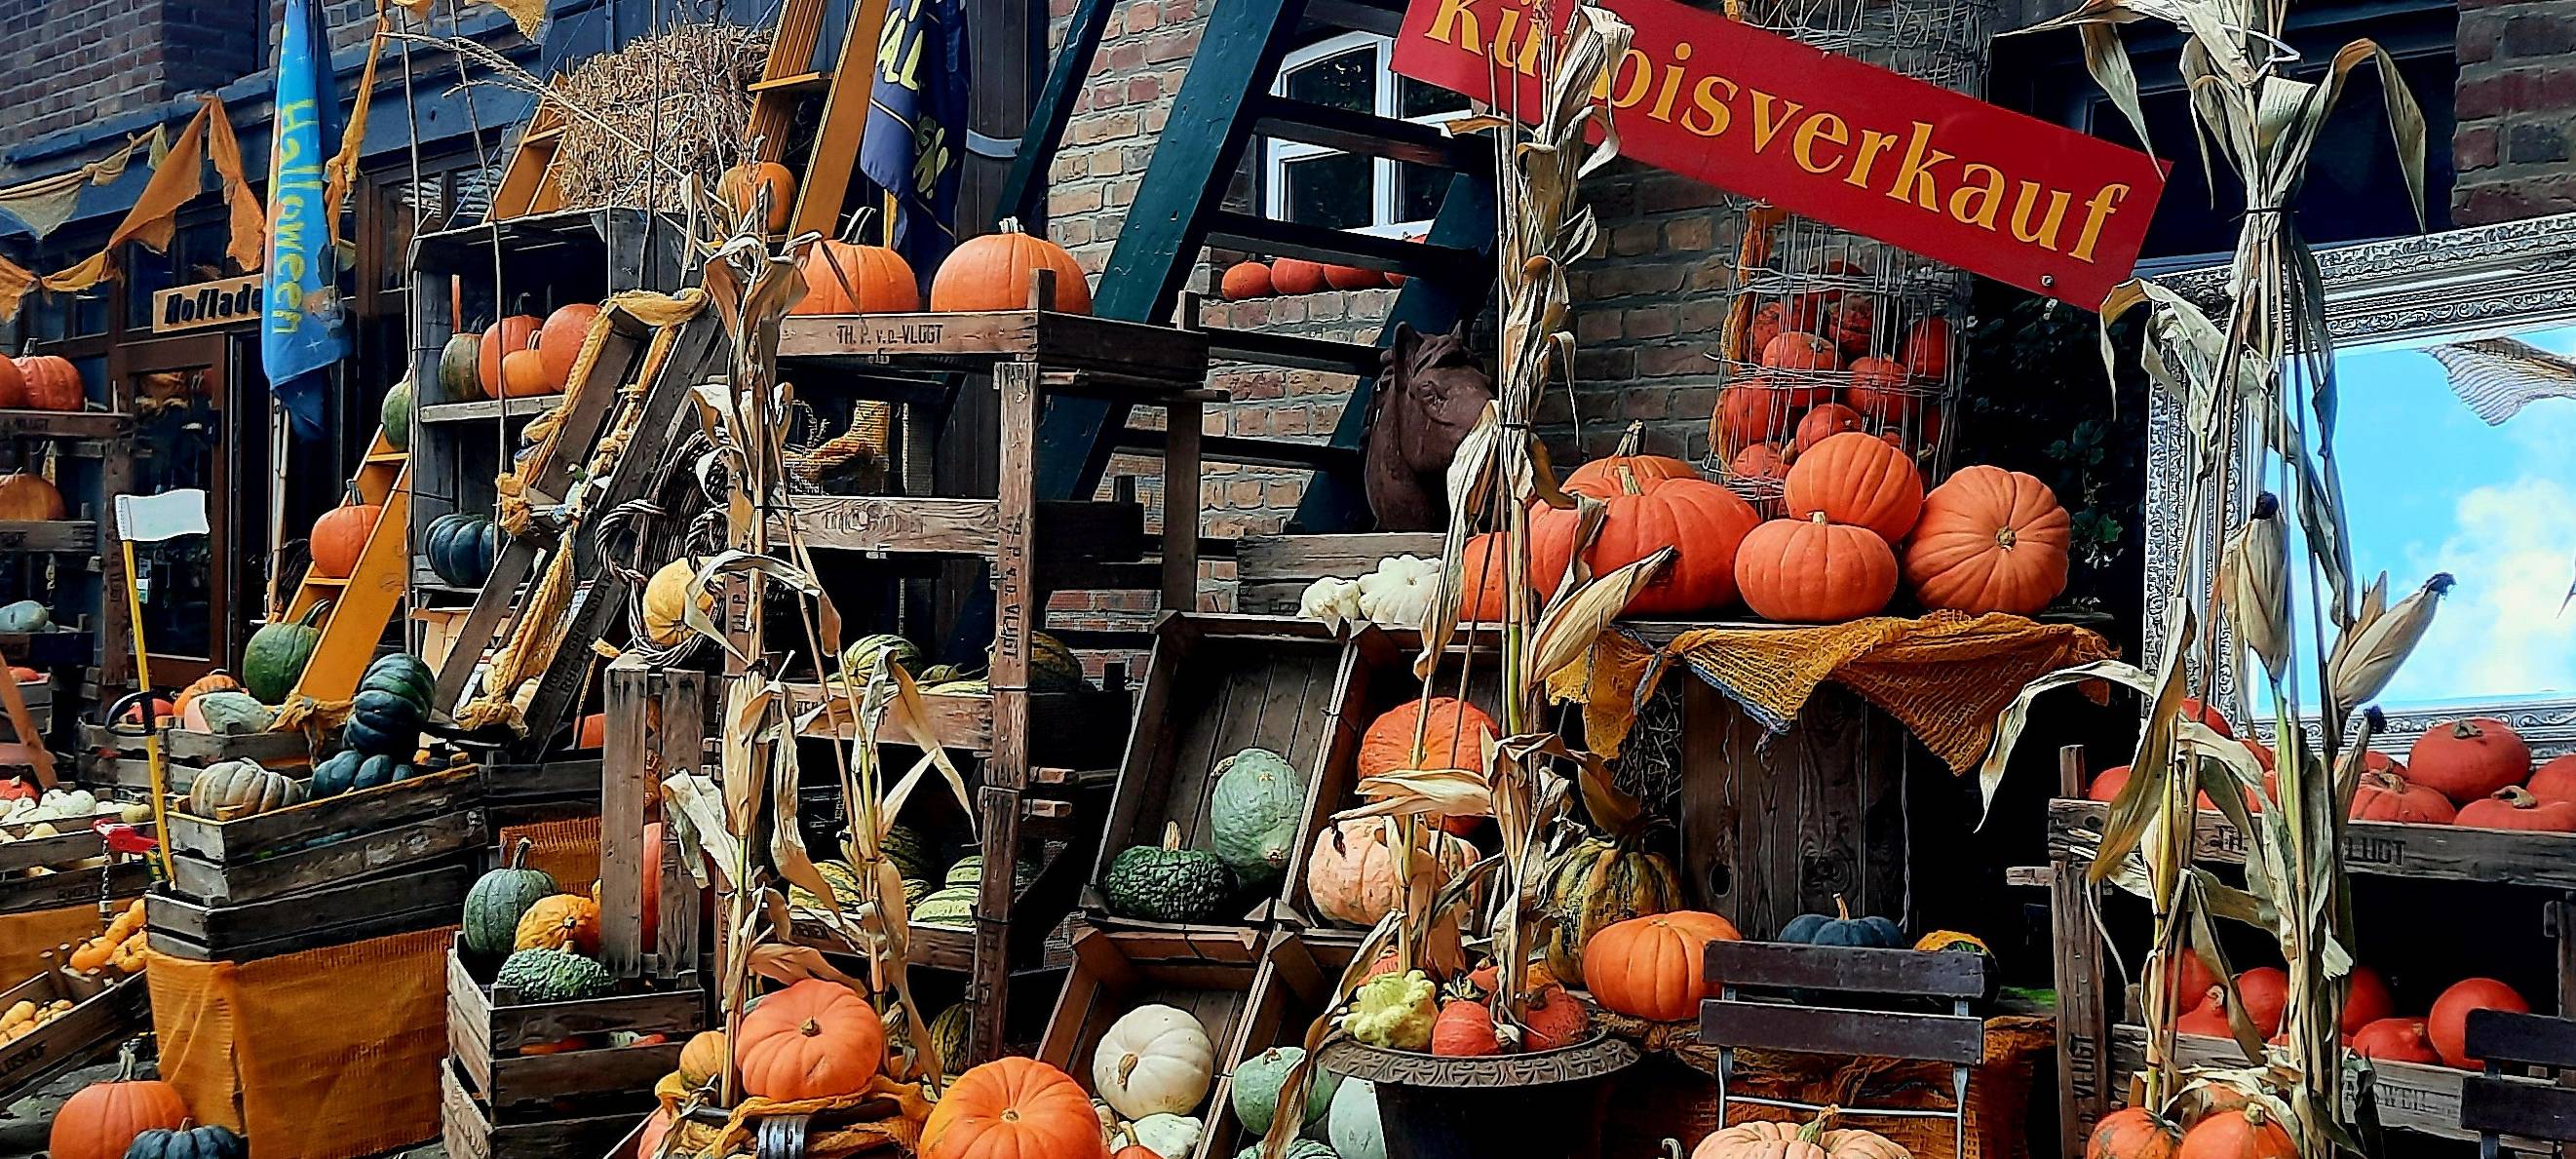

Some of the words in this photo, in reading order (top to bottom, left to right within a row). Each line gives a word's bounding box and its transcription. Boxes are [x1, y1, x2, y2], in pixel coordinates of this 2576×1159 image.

[1423, 0, 2131, 264] Kübisverkauf
[271, 98, 324, 335] Halloween
[164, 283, 263, 325] Hoflade
[2345, 836, 2406, 867] LUGT
